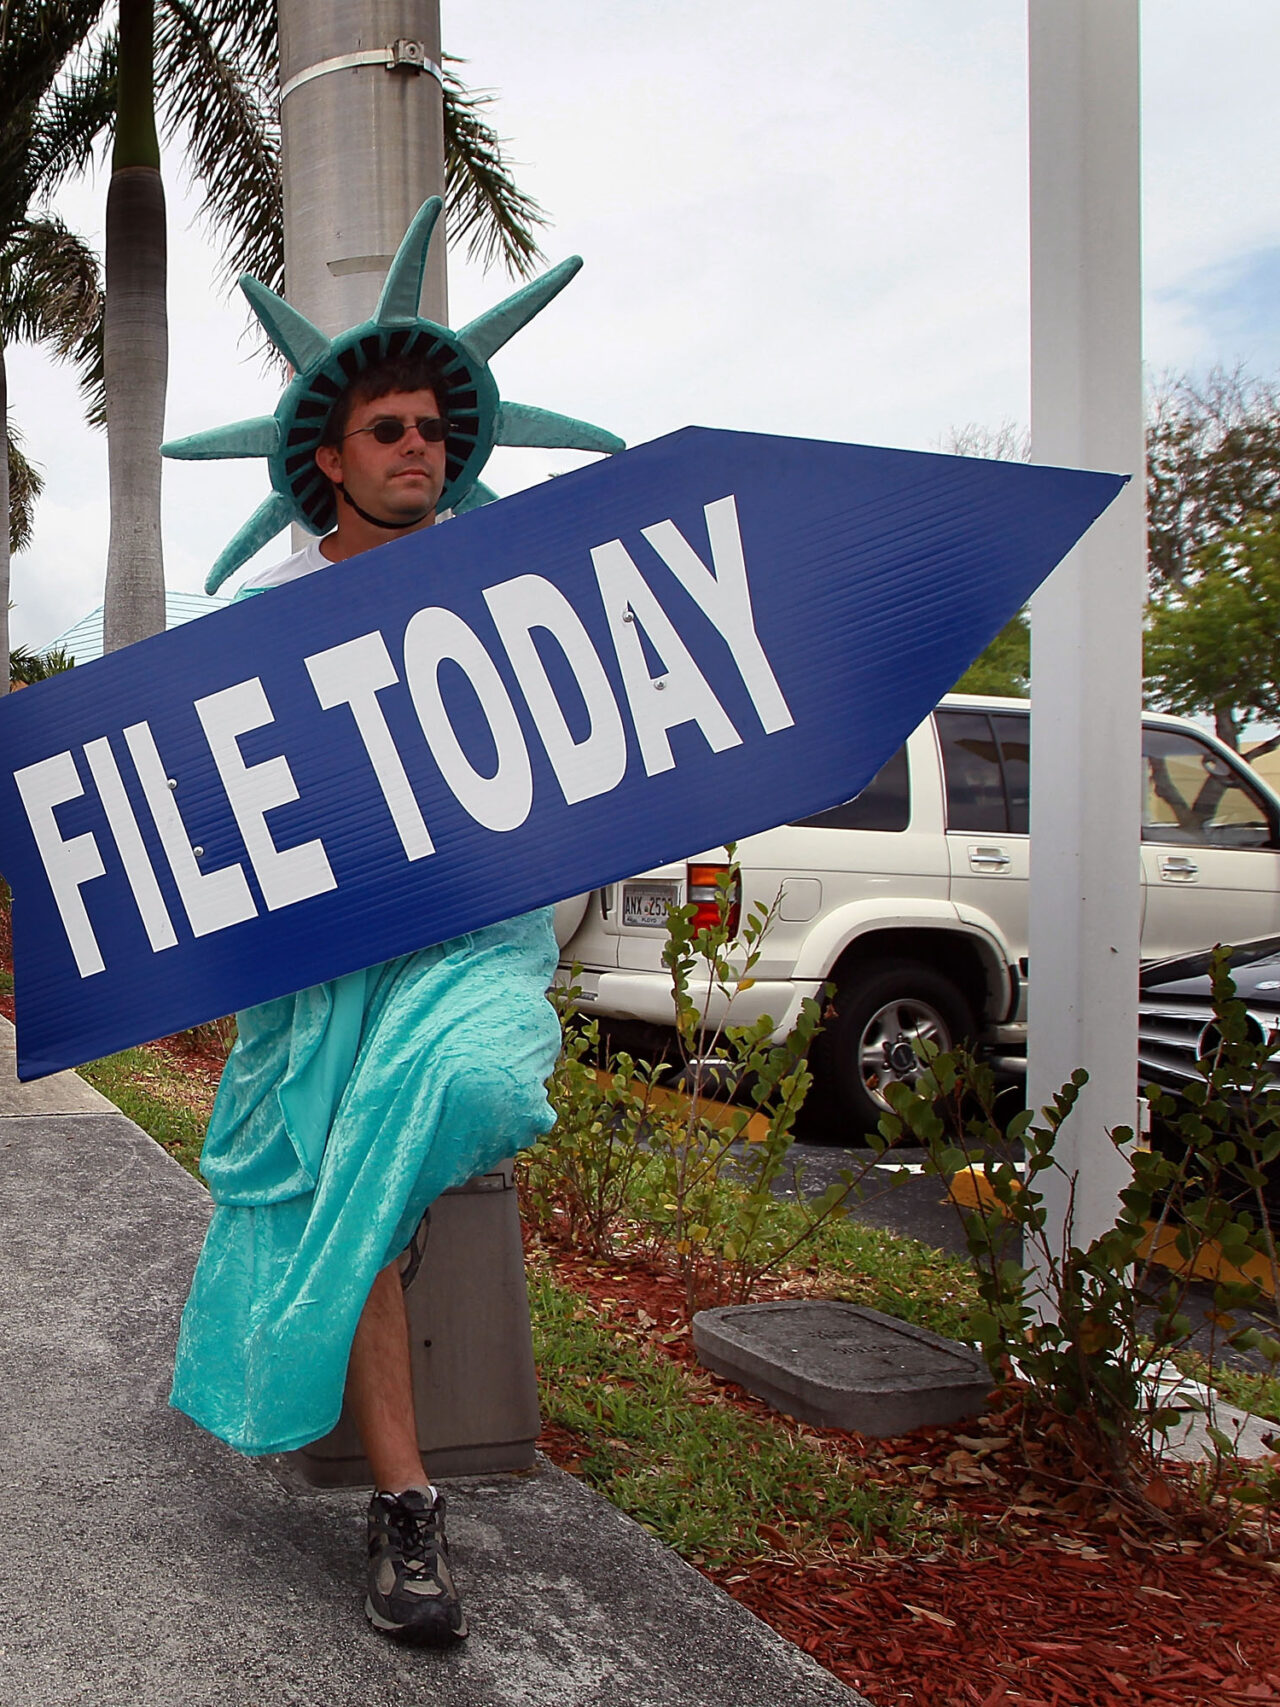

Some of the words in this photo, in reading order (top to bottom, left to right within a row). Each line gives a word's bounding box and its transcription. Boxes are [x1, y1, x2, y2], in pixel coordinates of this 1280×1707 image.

[13, 676, 338, 979] FILE
[304, 494, 795, 862] TODAY
[625, 896, 642, 915] ANX
